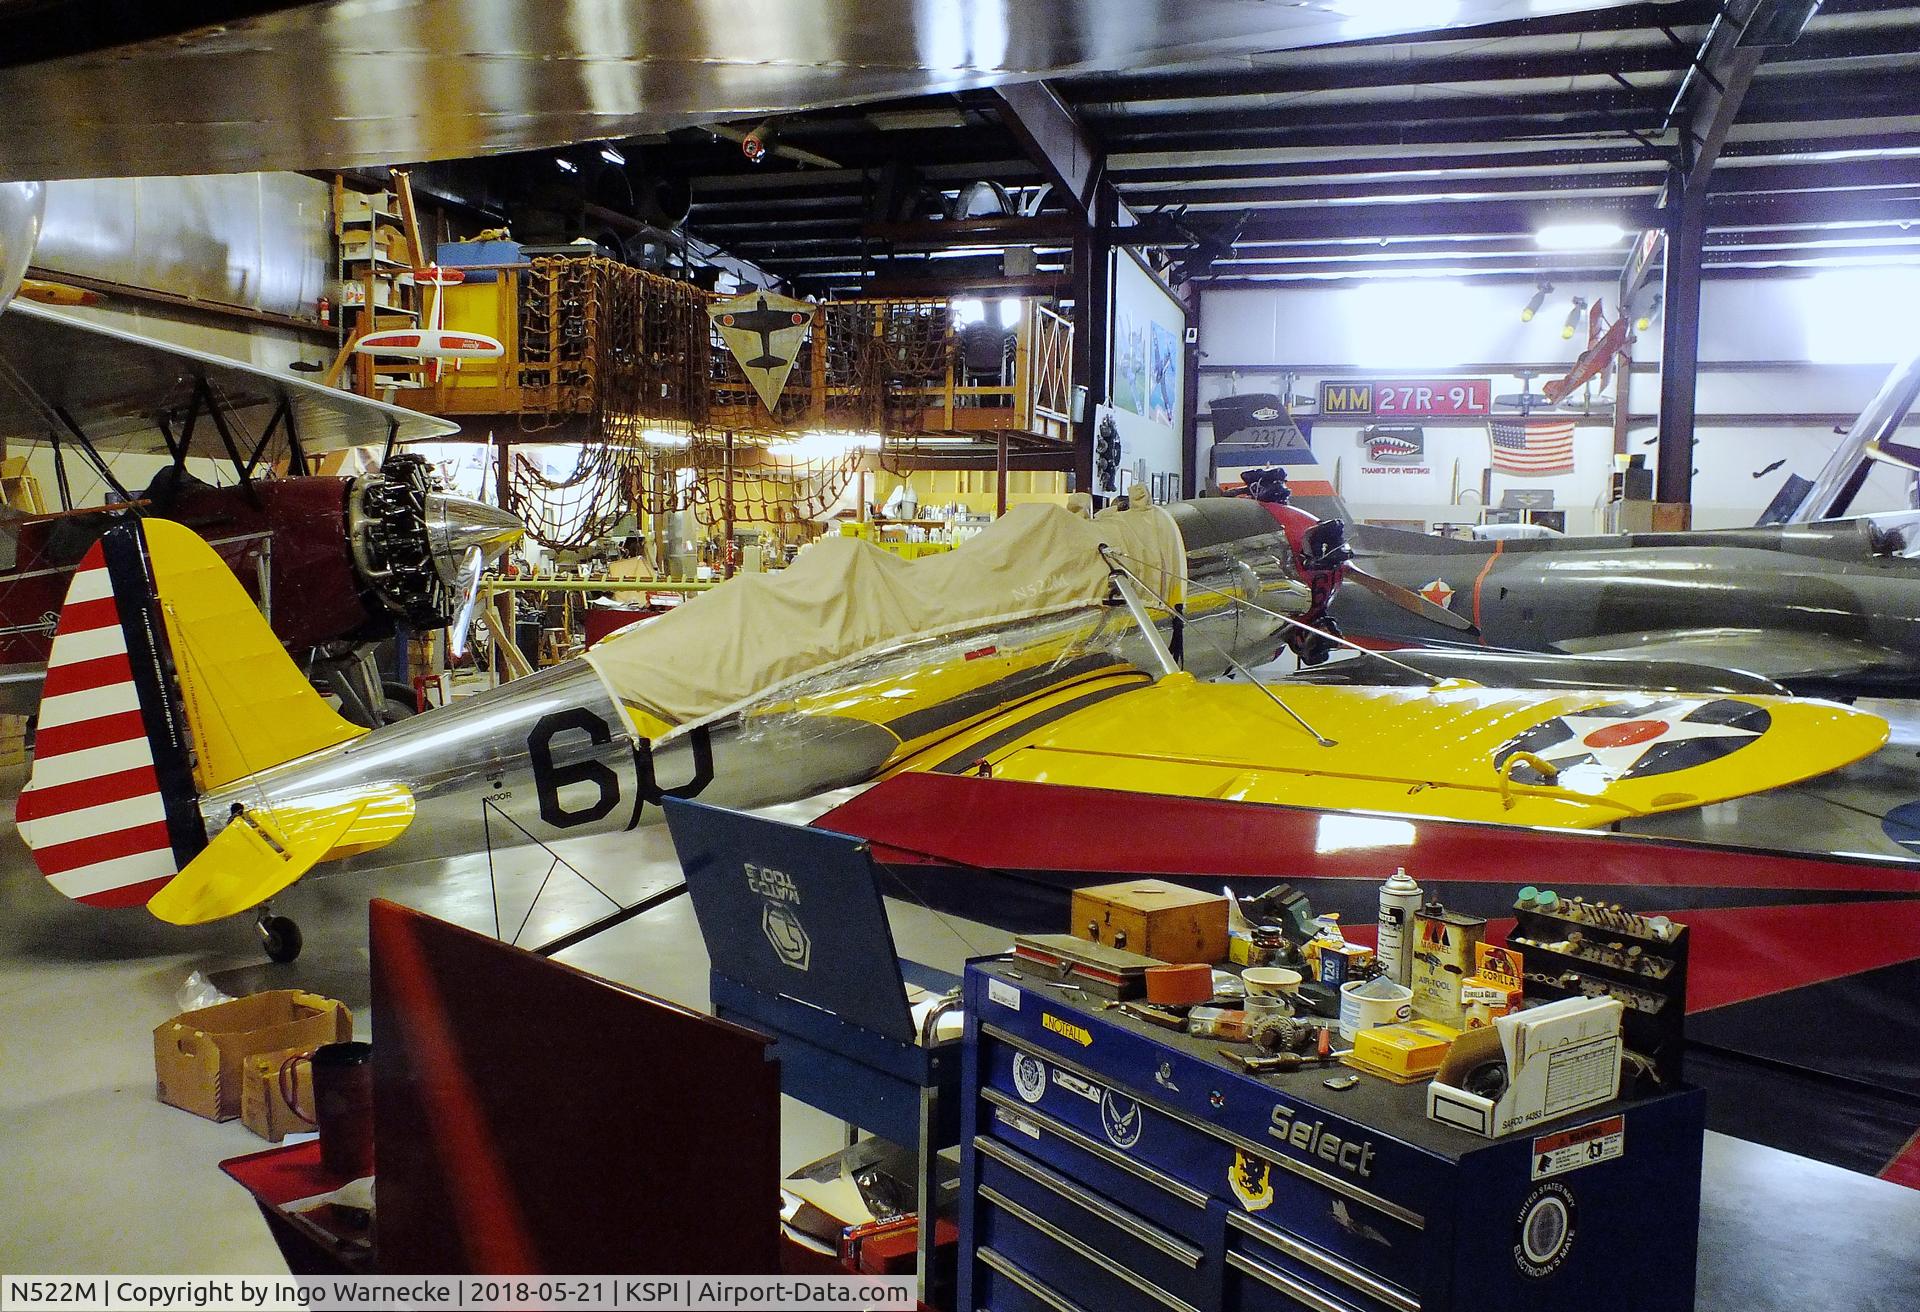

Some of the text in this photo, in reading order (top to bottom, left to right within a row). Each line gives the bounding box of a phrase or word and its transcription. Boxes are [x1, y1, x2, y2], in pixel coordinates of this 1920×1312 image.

[1328, 387, 1484, 411] MM 27R-9L
[1420, 940, 1452, 955] MARVEL
[1324, 960, 1336, 981] 120
[1482, 970, 1516, 987] GORILLA
[1428, 987, 1439, 997] OIL
[1048, 1016, 1083, 1043] NOTFALL
[1268, 1103, 1377, 1177] Select
[1517, 1182, 1575, 1224] UNITED STATES NAVY
[1513, 1229, 1576, 1278] ELECTRICIAN'S MATE
